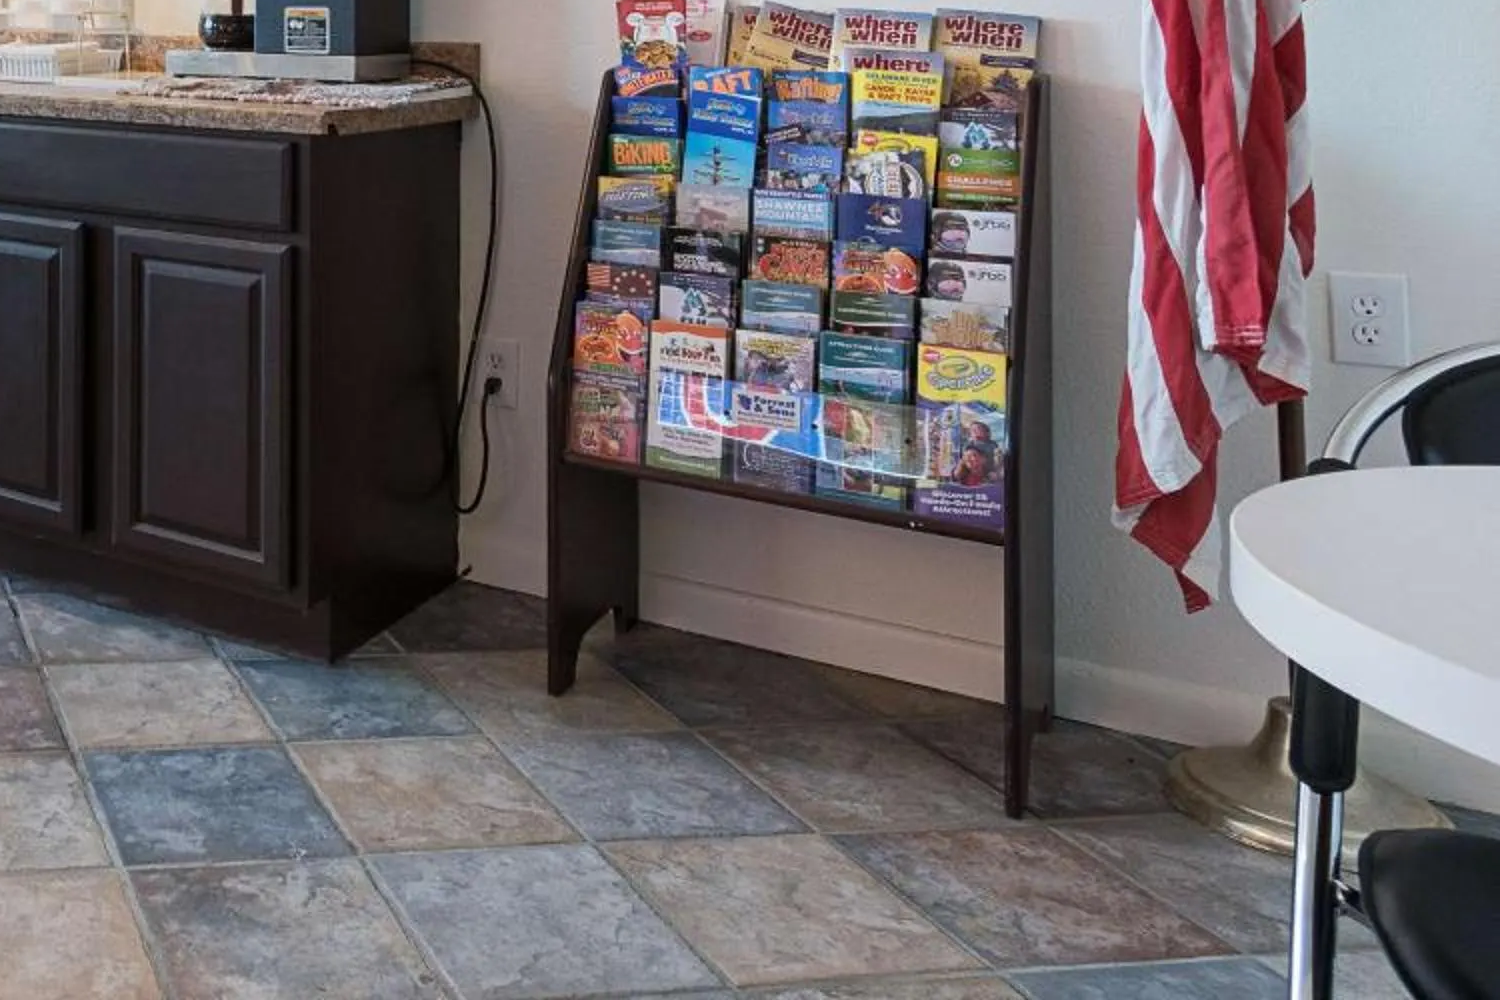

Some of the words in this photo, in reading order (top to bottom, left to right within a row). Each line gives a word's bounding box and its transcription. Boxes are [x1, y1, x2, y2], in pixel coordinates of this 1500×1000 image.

[844, 14, 918, 33] where
[944, 15, 1025, 35] where
[850, 25, 917, 45] when
[950, 25, 1022, 48] when
[853, 53, 932, 73] where
[753, 395, 795, 409] Forrest
